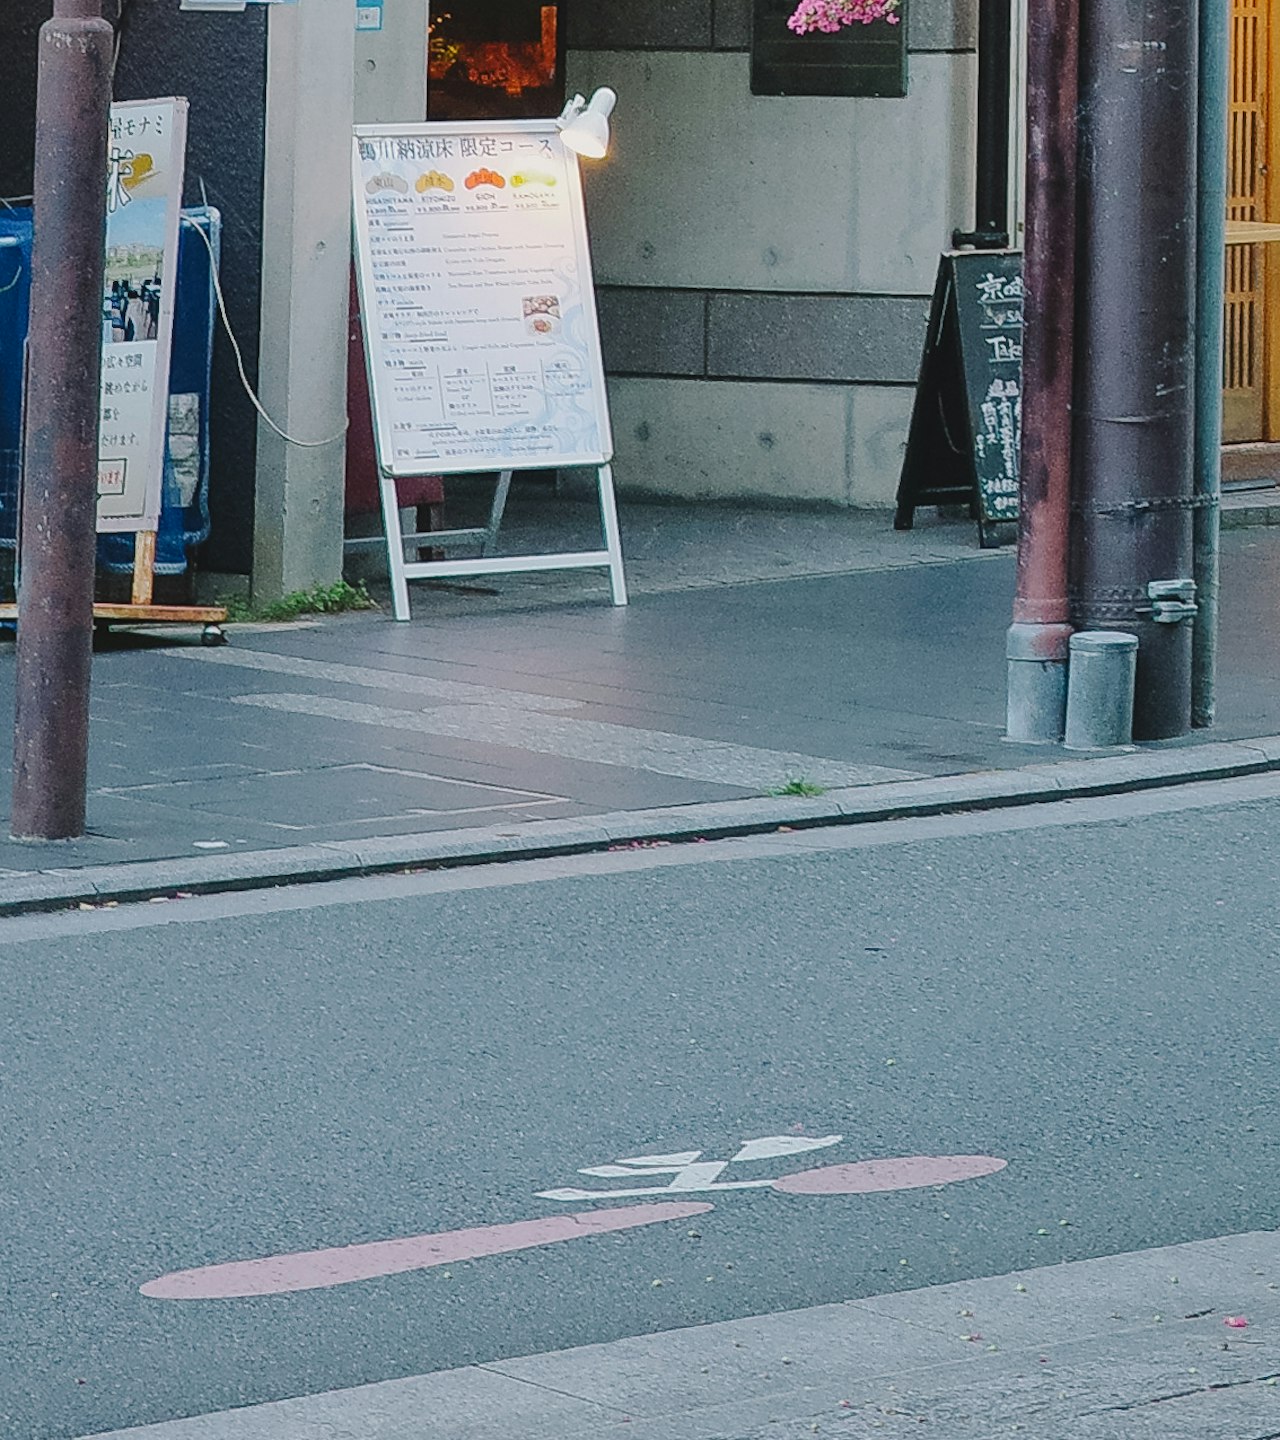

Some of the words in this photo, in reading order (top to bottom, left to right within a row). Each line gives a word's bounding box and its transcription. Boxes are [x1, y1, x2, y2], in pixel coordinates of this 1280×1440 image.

[358, 137, 454, 162] 鴨川納涼床
[459, 136, 553, 158] 限定コース
